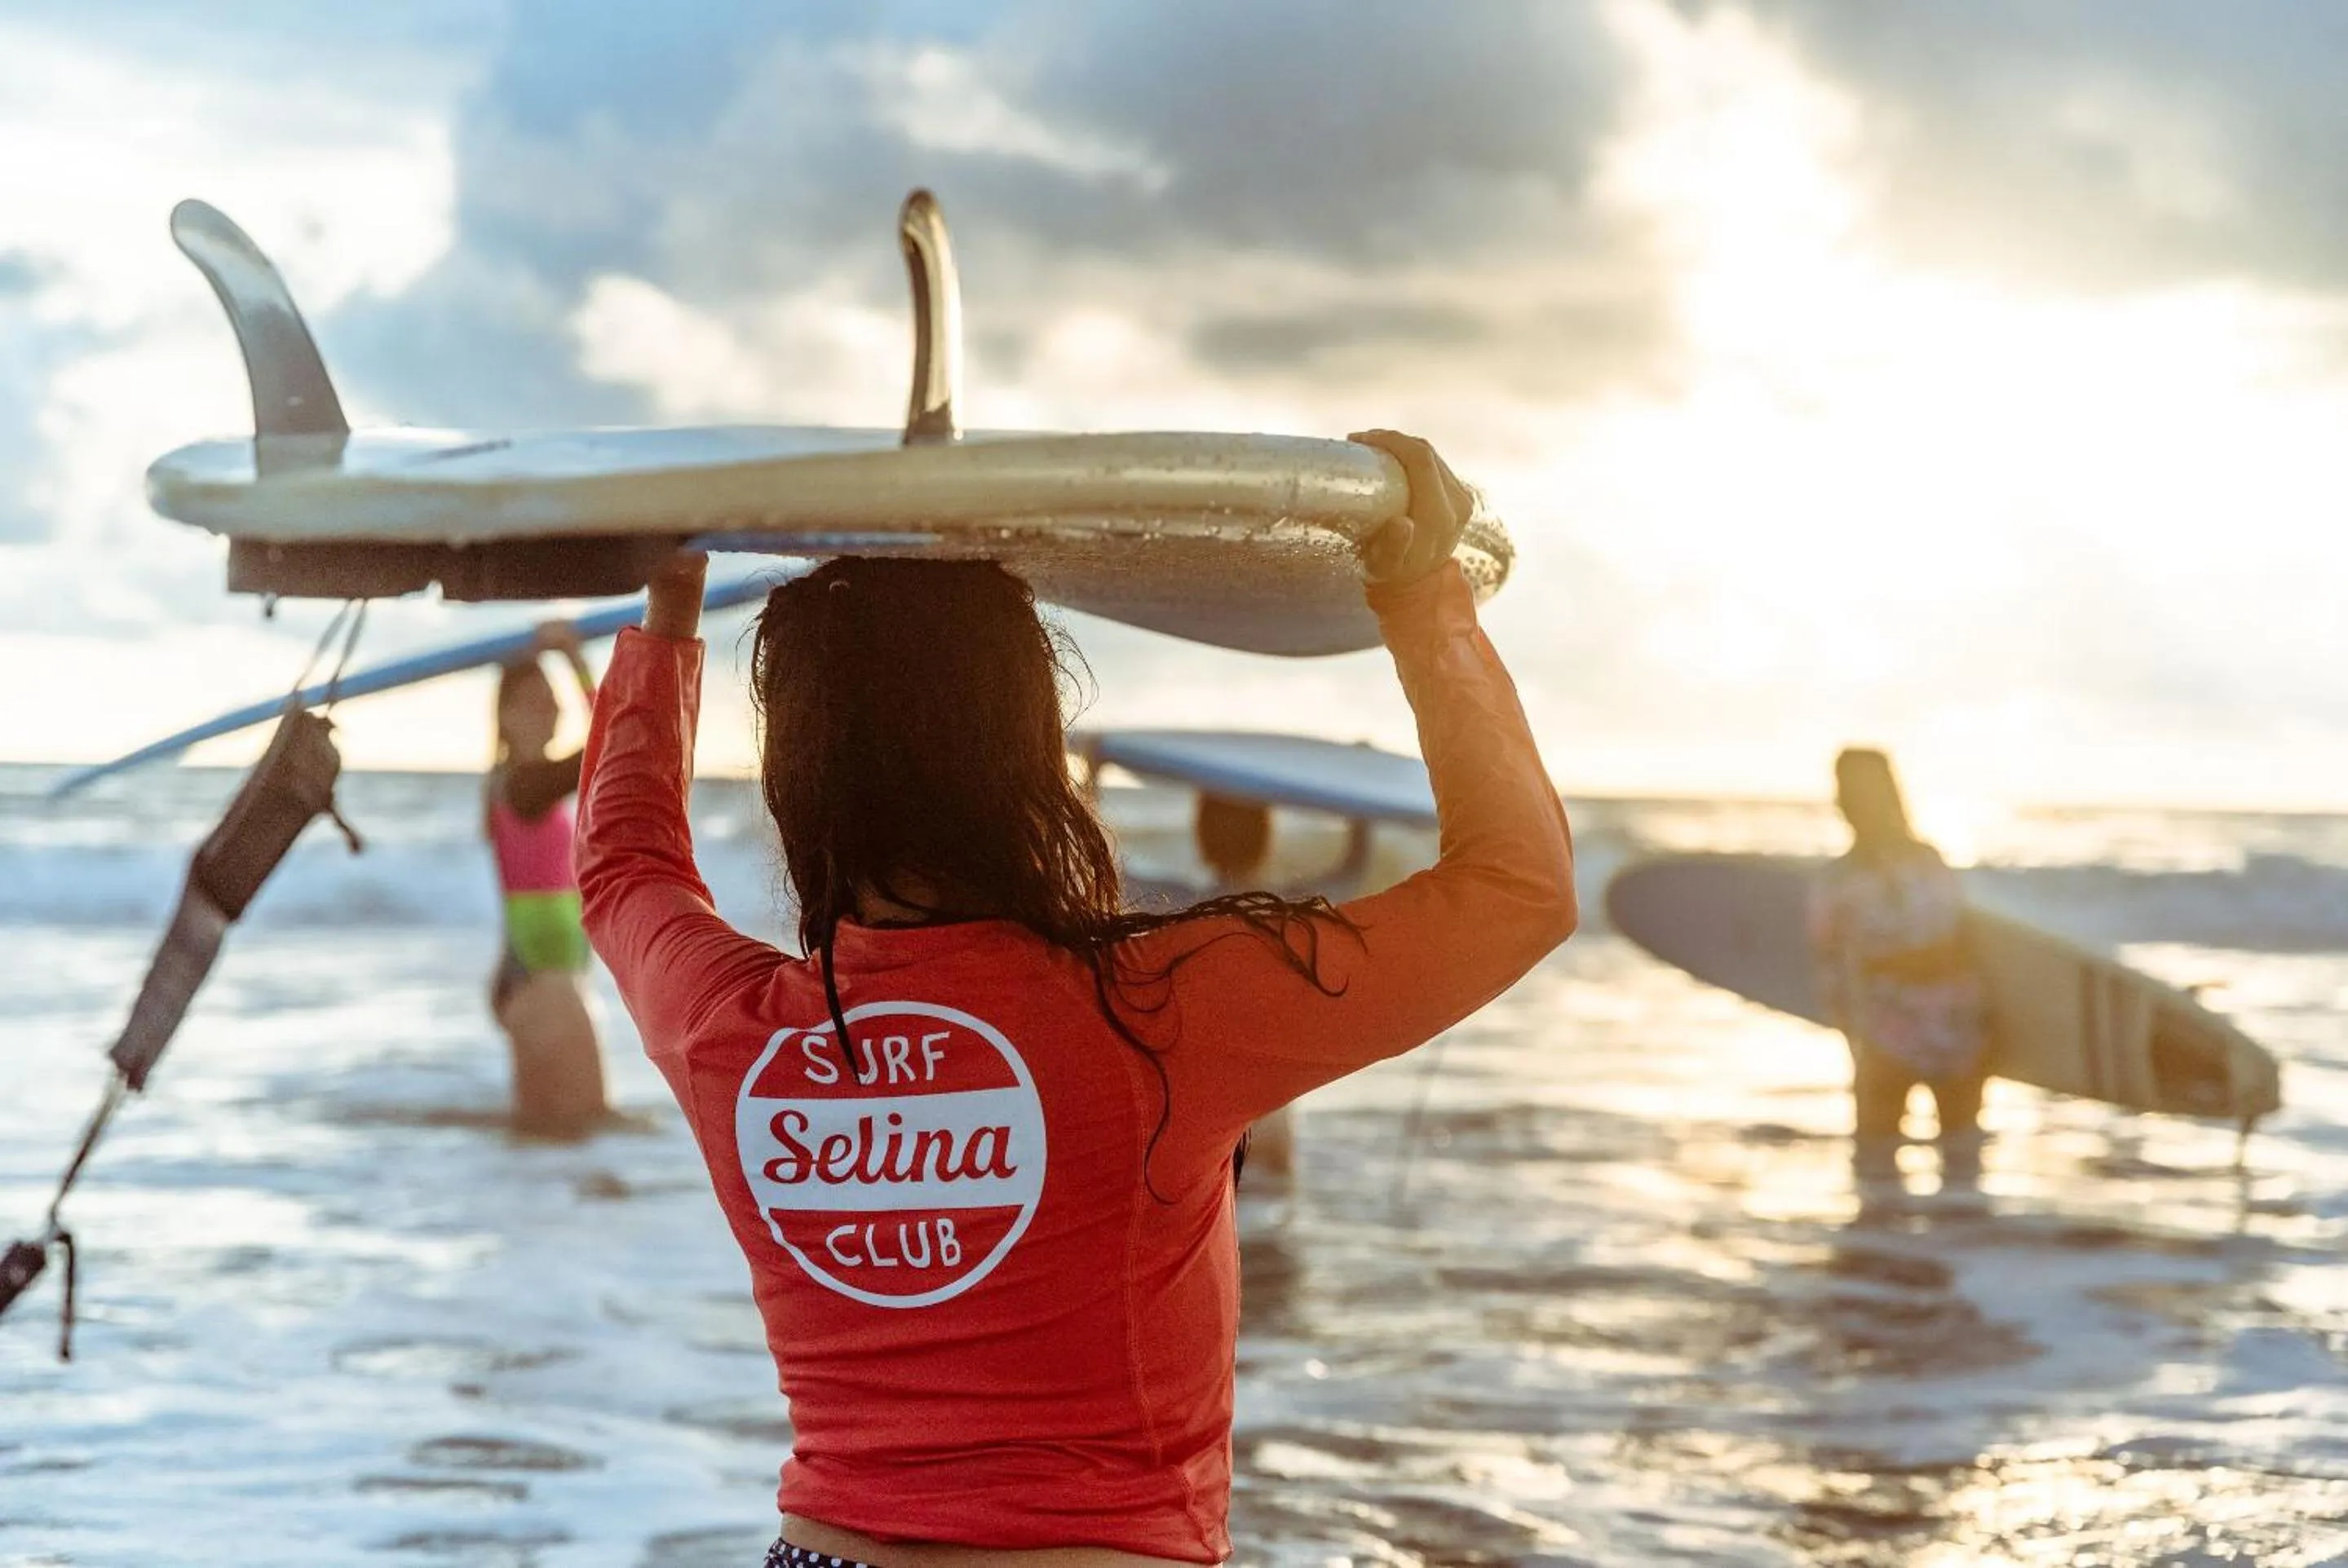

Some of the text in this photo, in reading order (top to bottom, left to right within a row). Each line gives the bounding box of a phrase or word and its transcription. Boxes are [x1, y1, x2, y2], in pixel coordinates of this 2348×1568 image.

[801, 1031, 950, 1086] SURF
[763, 1110, 1018, 1185] Selina
[825, 1217, 962, 1269] CLUB
